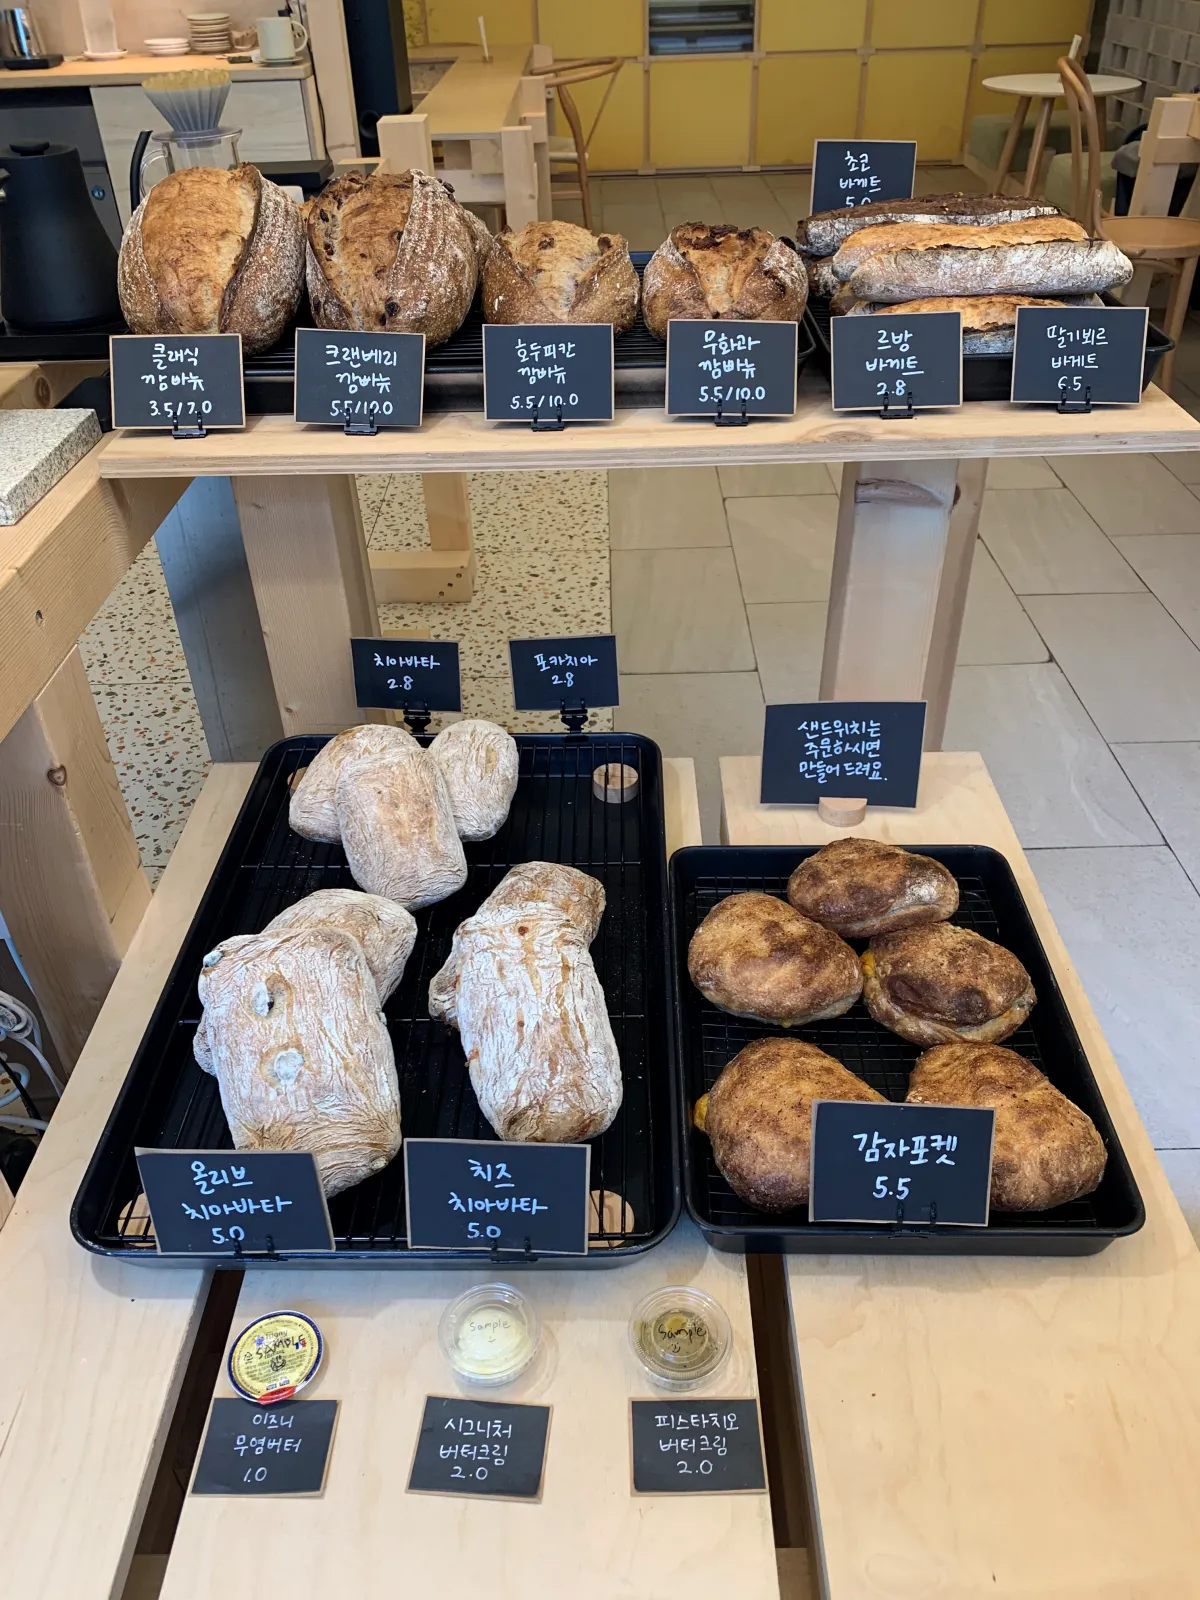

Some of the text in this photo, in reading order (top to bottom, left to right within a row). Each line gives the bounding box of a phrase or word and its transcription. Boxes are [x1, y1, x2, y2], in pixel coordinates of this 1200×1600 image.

[844, 150, 871, 173] 초코
[702, 329, 761, 356] 무화과
[877, 329, 913, 353] 르방
[1046, 324, 1109, 349] 딸기뵈르
[152, 343, 199, 371] 클래식
[325, 344, 397, 369] 크랜베리
[514, 338, 576, 363] 호두피칸
[1051, 353, 1099, 369] 바게트
[876, 379, 907, 396] 2.8
[1057, 375, 1083, 391] 6.5
[509, 393, 579, 410] 5.5/10.0
[698, 385, 766, 403] 5.5/10.0
[149, 400, 212, 418] 3.5/7.0
[329, 399, 394, 419] 5.5/10.0
[373, 652, 441, 670] 치아바타
[533, 653, 599, 672] 포카치아
[387, 675, 414, 691] 2.8
[551, 671, 575, 688] 2.8
[797, 719, 881, 740] 샌드위치는
[803, 735, 881, 760] 주문하시면
[799, 760, 840, 784] 만들어
[852, 1131, 958, 1166] 감자포켓
[190, 1160, 254, 1195] 올리브
[467, 1159, 515, 1189] 치즈
[872, 1175, 912, 1200] 5.5
[181, 1192, 293, 1221] 치아바타
[447, 1191, 549, 1215] 치아바타
[211, 1225, 245, 1245] 5.0
[467, 1222, 501, 1239] 5.0
[470, 1319, 511, 1333] Sample
[657, 1322, 706, 1343] Sample
[252, 1412, 294, 1429] 이즈니
[444, 1417, 512, 1439] 시그니처
[654, 1413, 739, 1431] 피스타치오
[233, 1434, 302, 1457] 무염버터
[439, 1444, 508, 1466] 버터크림
[659, 1435, 728, 1456] 버터크림
[243, 1466, 267, 1483] 1.0
[450, 1465, 488, 1480] 2.0
[676, 1459, 713, 1475] 2.0
